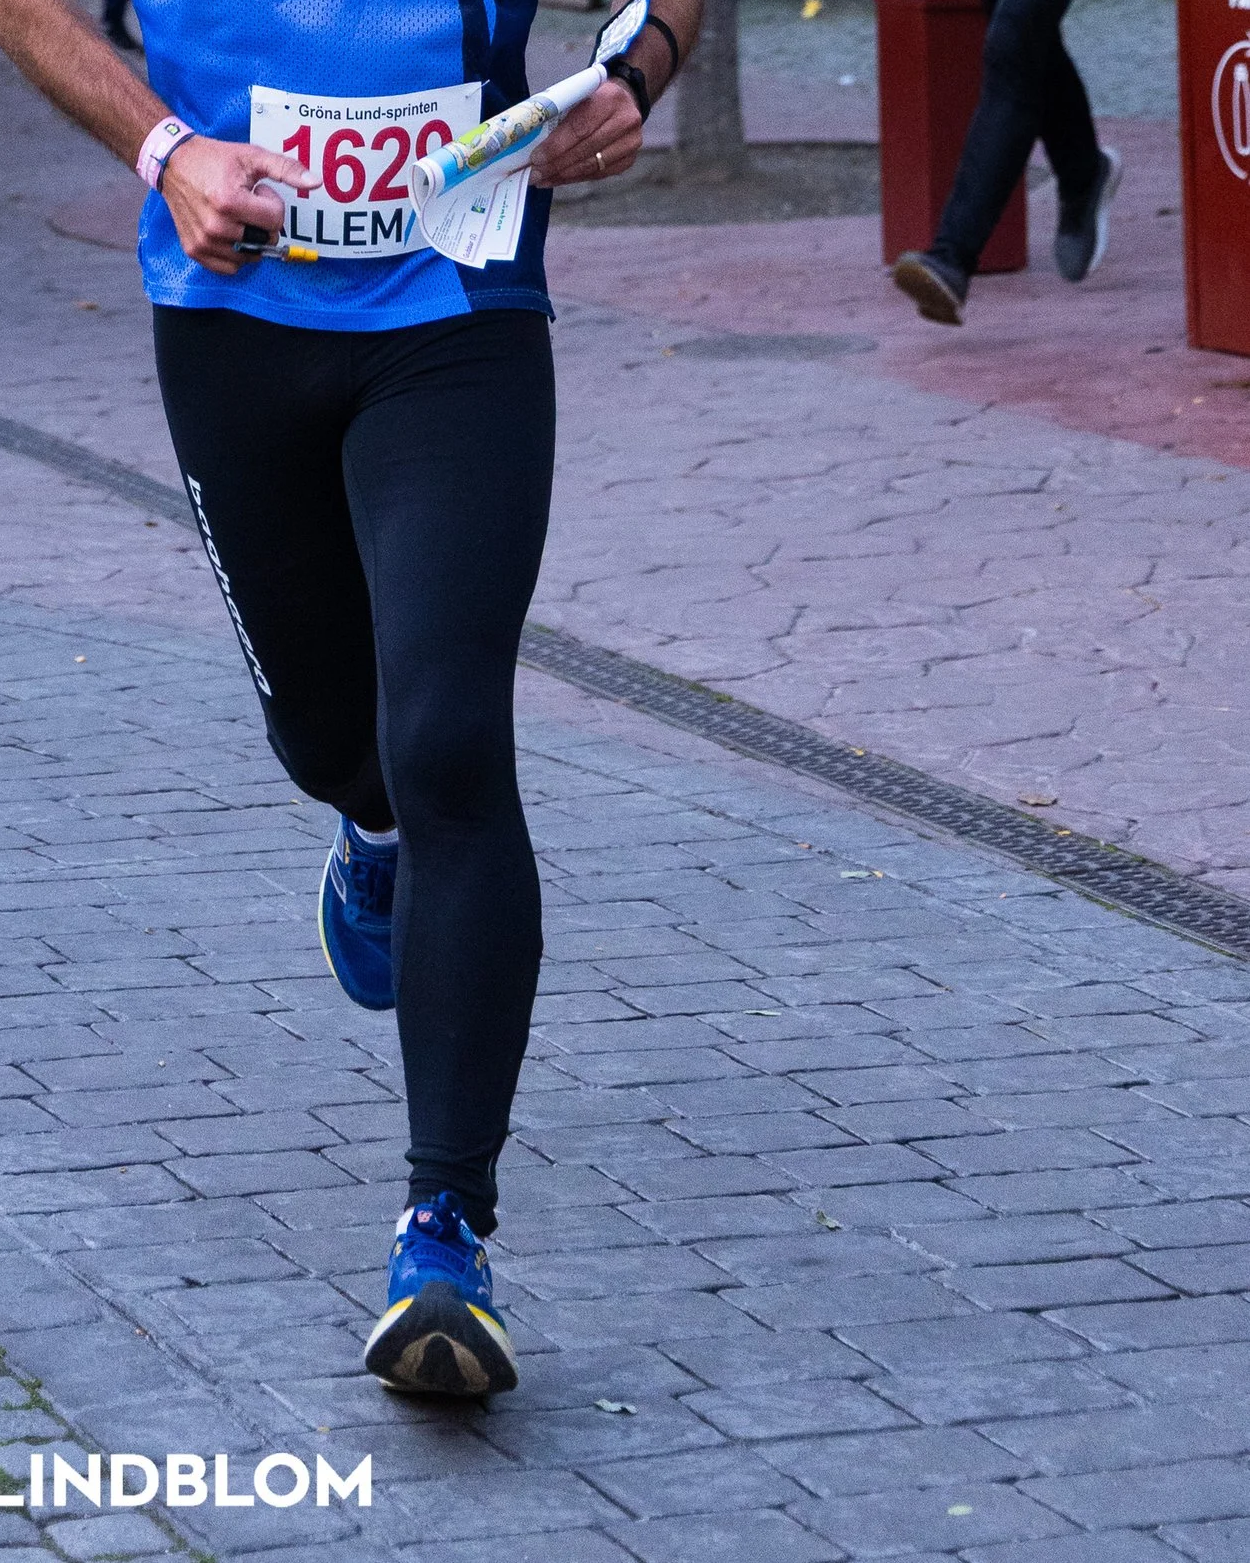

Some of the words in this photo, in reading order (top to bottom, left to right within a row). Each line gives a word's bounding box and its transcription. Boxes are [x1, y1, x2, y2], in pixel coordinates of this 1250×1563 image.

[298, 103, 342, 120] Gröna
[346, 100, 439, 121] Lund-sprinten
[187, 472, 272, 697] bagheera
